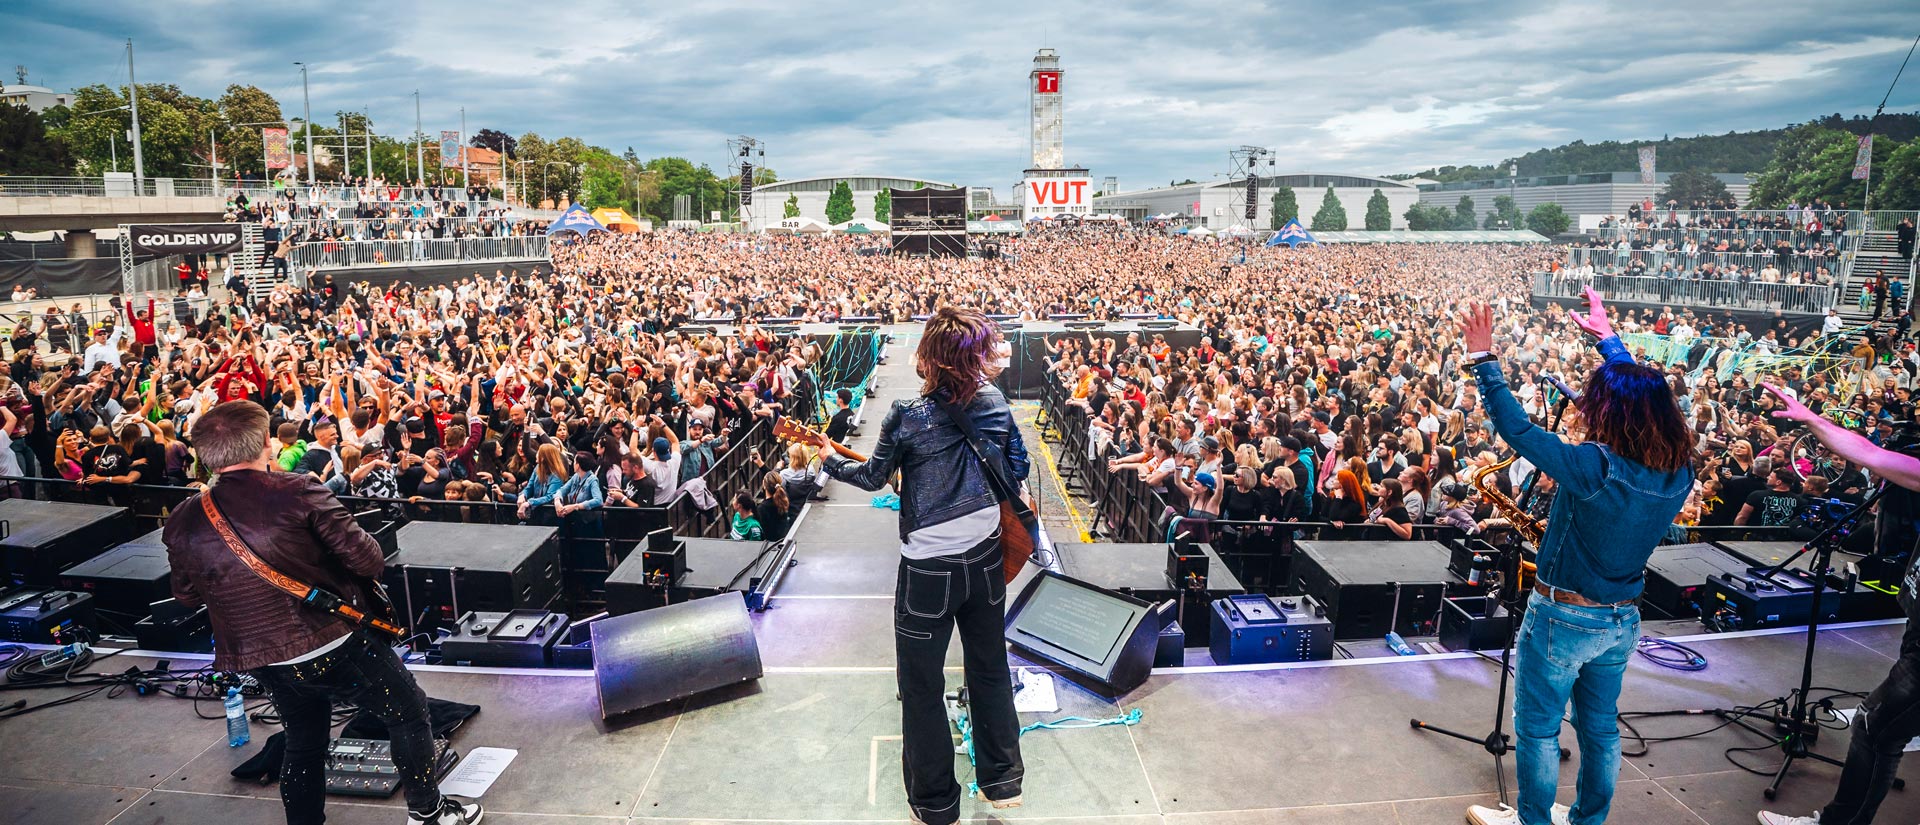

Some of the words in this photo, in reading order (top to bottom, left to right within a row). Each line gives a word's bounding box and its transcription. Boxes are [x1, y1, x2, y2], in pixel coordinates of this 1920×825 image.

[1041, 75, 1056, 90] T
[1031, 181, 1087, 204] VUT
[138, 233, 208, 246] GOLDEN
[209, 233, 237, 245] VIP
